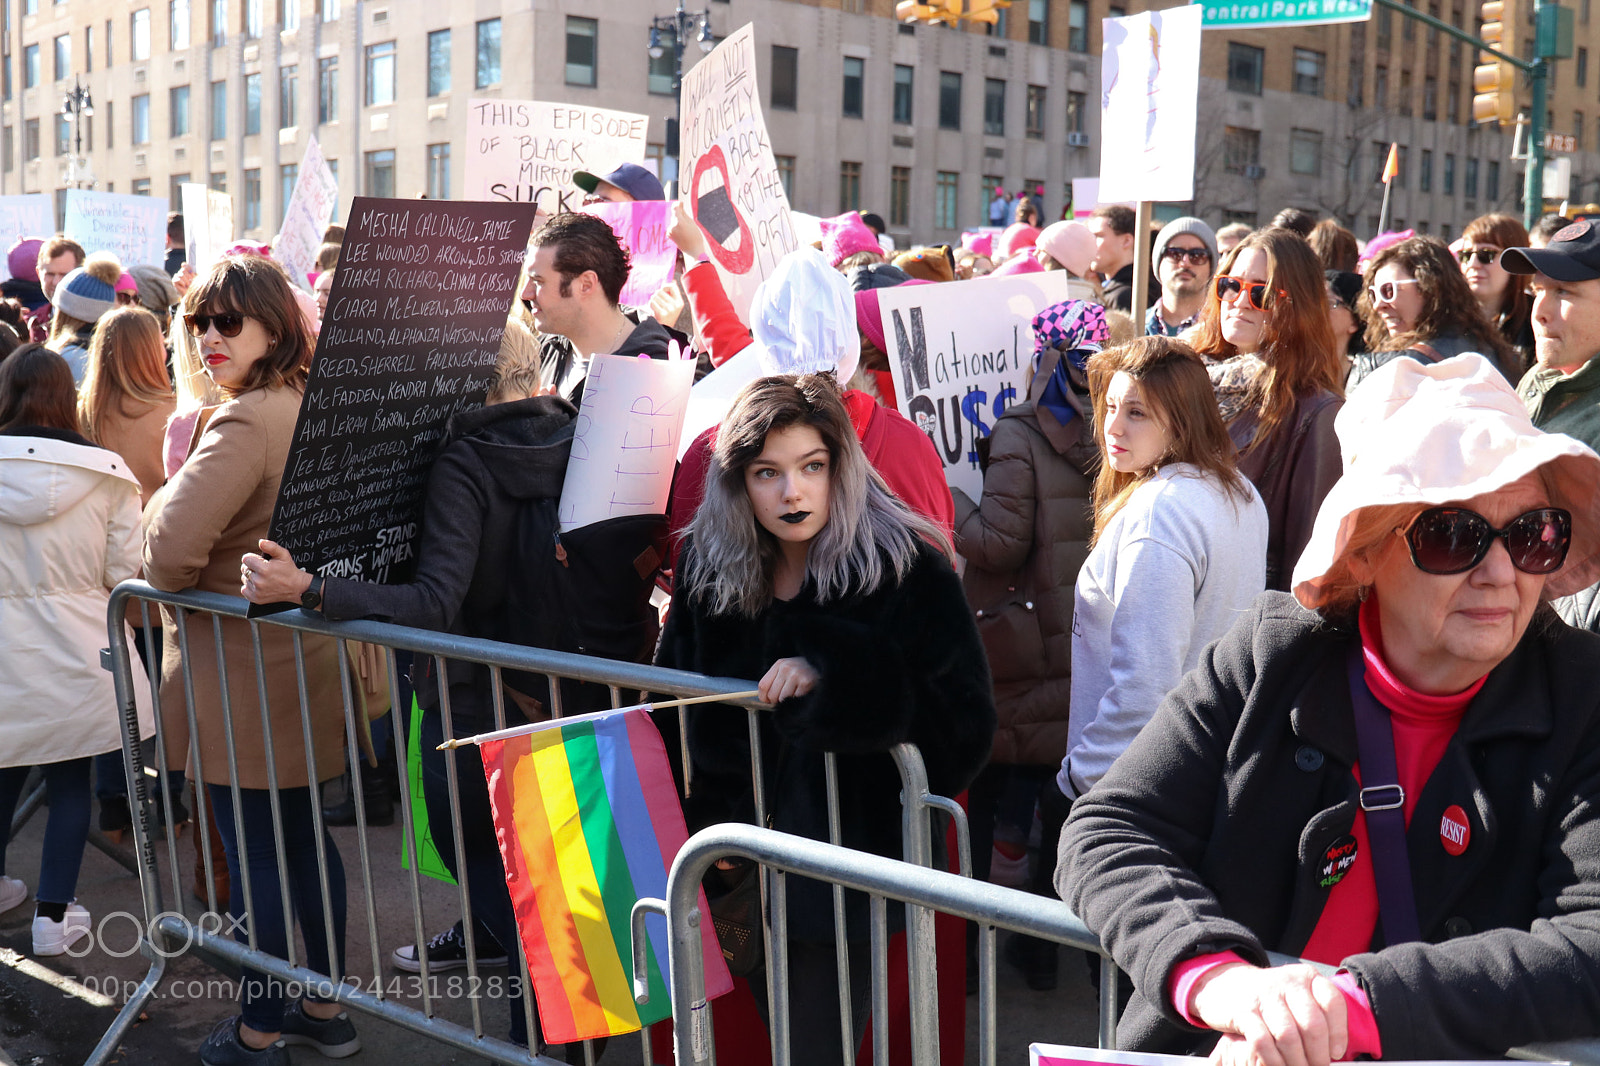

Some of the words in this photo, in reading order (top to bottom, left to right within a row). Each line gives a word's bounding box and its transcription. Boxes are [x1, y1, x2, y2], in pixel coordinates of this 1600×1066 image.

[1271, 1, 1317, 18] Park
[722, 35, 749, 82] NOT
[474, 102, 530, 128] THIS
[553, 107, 645, 140] EPISODE
[703, 85, 756, 150] QUIETLY
[479, 136, 501, 154] OF
[728, 129, 769, 175] BACK
[751, 168, 784, 207] THE
[92, 218, 148, 244] Diversity
[360, 209, 410, 240] MESHA
[414, 212, 479, 244] CALDWELL,
[480, 219, 517, 243] JAMIE
[345, 242, 371, 264] LEE
[374, 243, 431, 266] WOUNDED
[433, 244, 474, 269] ARROW,
[340, 267, 381, 290] TIARA
[384, 267, 442, 292] RICHARD,
[442, 269, 477, 291] CHYNA
[478, 272, 517, 297] GIBSON
[332, 296, 378, 322] CIARA
[449, 295, 512, 315] JAQUARRIUS
[325, 325, 387, 349] HOLLAND,
[387, 327, 440, 347] ALPHONZA
[441, 321, 485, 347] WATSON,
[317, 356, 359, 380] REED,
[359, 354, 417, 377] SHERRELL
[424, 347, 478, 373] FAULKNER,
[890, 306, 1019, 401] National
[387, 380, 428, 401] KENDRA
[430, 374, 460, 397] MARIE
[299, 418, 327, 443] AVA
[412, 404, 449, 427] EBONY
[290, 446, 316, 481] TEE
[316, 444, 337, 472] TEE
[339, 442, 409, 470] DANGERFIELD,
[283, 471, 343, 498] GWYNEVERE
[278, 494, 323, 520] NAZIER
[275, 507, 342, 538] STEINFELD,
[316, 520, 365, 545] BROOKLYN
[375, 522, 417, 549] STAND
[371, 542, 414, 571] WOMEN
[124, 700, 144, 774] FRIEDRICHS
[1440, 816, 1467, 846] RESIST
[1326, 840, 1357, 861] NASTY
